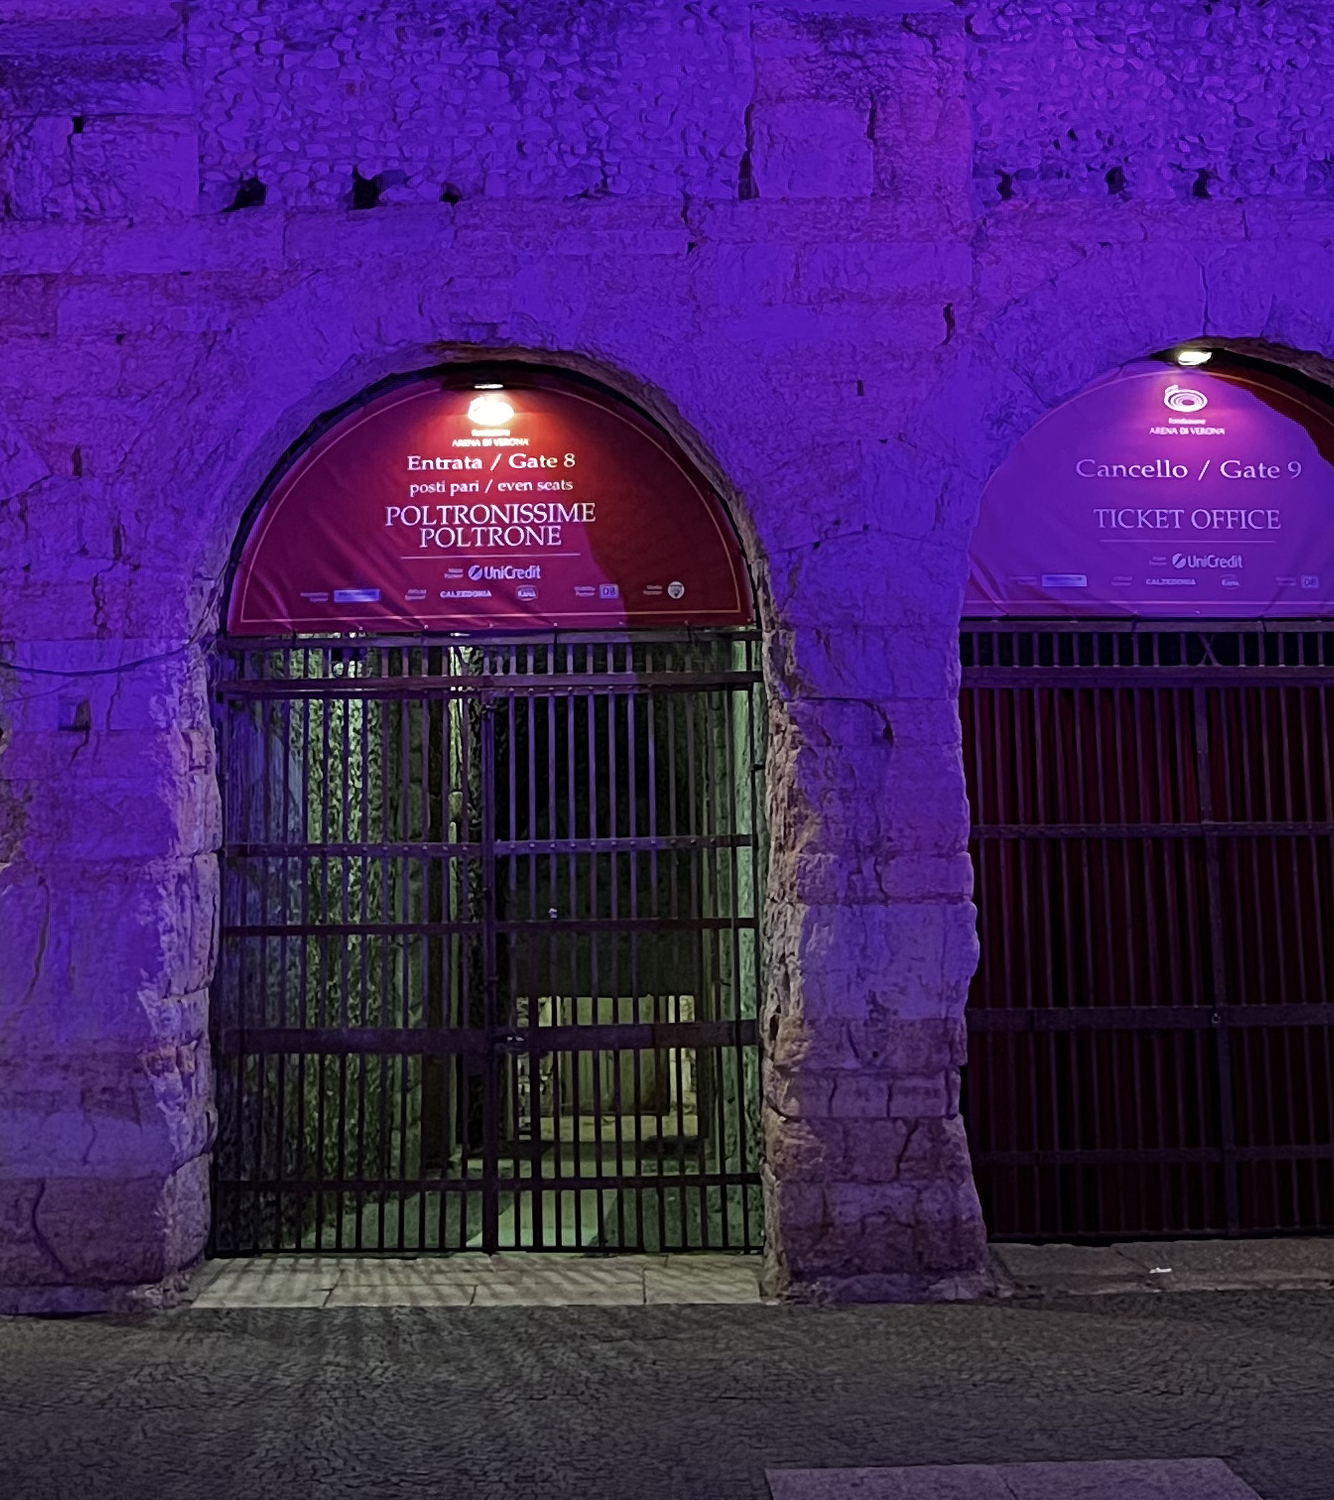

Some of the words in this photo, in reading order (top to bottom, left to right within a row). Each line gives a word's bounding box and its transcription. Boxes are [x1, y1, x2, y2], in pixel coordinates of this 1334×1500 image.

[1149, 427, 1177, 435] ARENA
[1190, 426, 1225, 435] VERONA
[407, 455, 483, 471] Entrata
[508, 453, 558, 469] Gate
[563, 453, 576, 468] 8
[1075, 459, 1188, 479] Cancello
[1220, 460, 1280, 479] Gate
[1287, 460, 1302, 479] 9
[409, 480, 446, 497] posti
[450, 480, 480, 496] pari
[497, 480, 533, 492] even
[537, 479, 574, 491] seats
[384, 502, 596, 526] POLTRONISSIME
[1093, 508, 1185, 529] TICKET
[1191, 508, 1282, 530] OFFICE
[419, 525, 562, 549] POLTRONE
[1187, 555, 1243, 568] UniCredit
[484, 565, 541, 580] UniCredit
